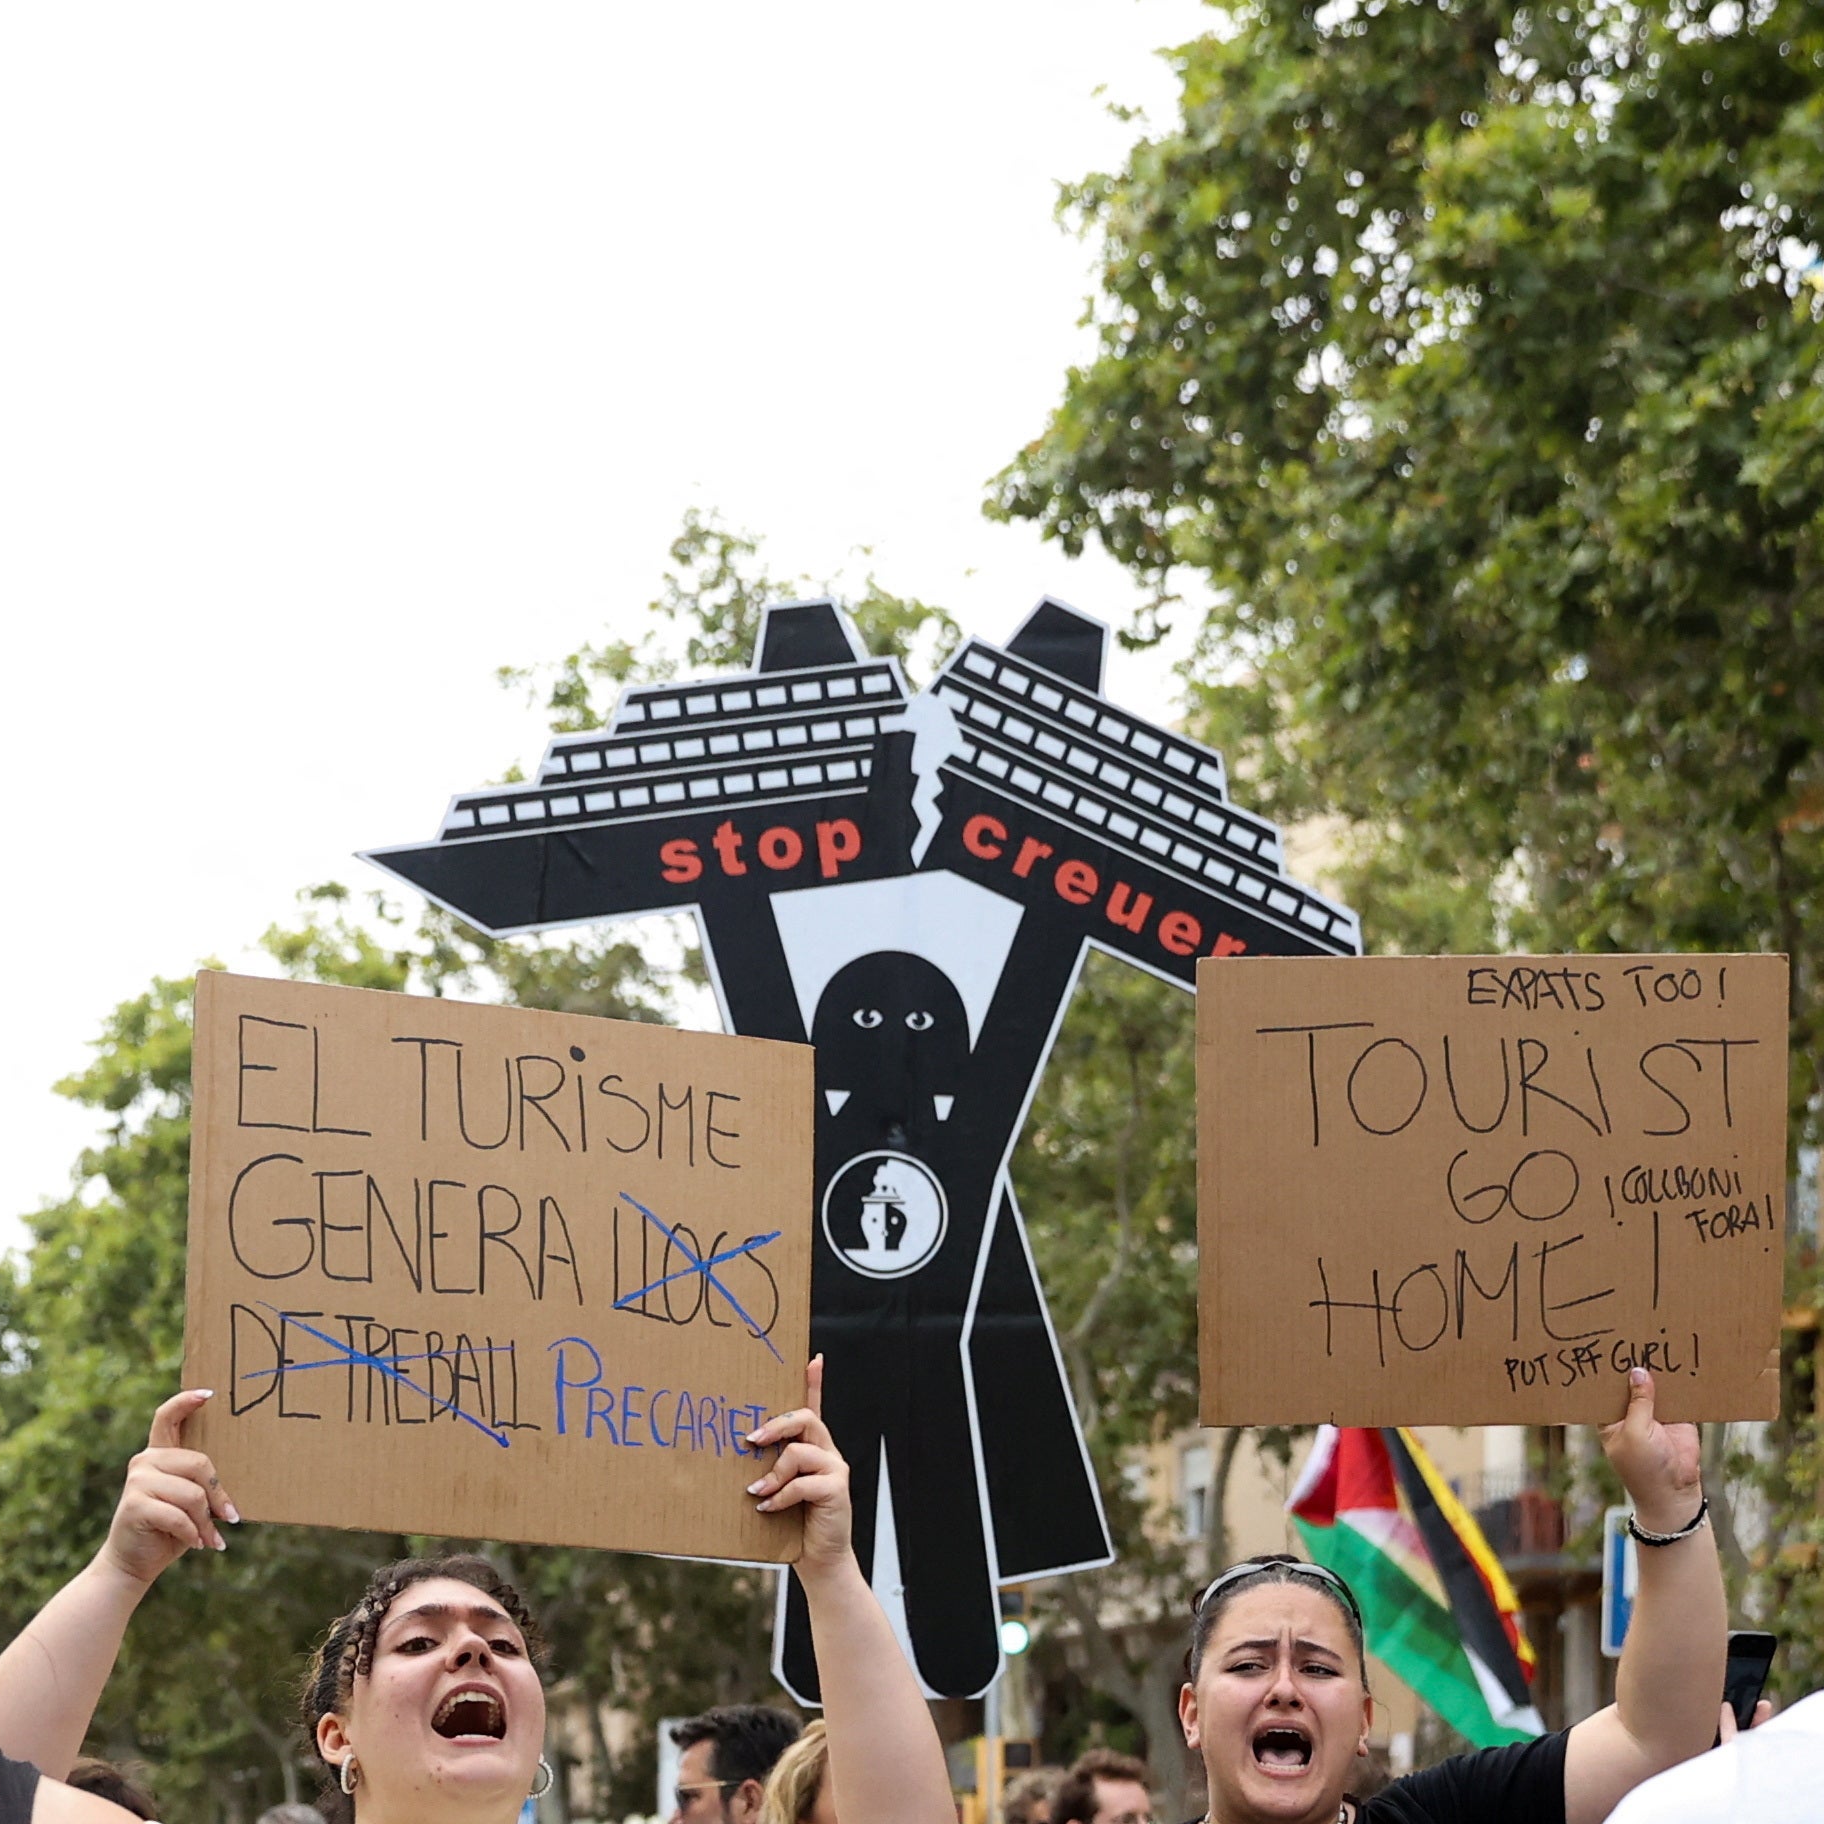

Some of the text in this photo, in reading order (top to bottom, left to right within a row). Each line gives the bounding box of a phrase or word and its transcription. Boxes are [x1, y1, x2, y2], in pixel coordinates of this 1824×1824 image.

[658, 812, 1269, 957] stop creuer
[1467, 967, 1605, 1011] EXPATS
[237, 1015, 740, 1169] EL TURISME
[1256, 1020, 1760, 1146] TOURIST
[229, 1153, 780, 1339] GENERA LLOCS
[1448, 1150, 1579, 1224] GO
[1684, 1193, 1774, 1253] FORA!
[230, 1303, 783, 1460] DE TREBALL PRECARIET
[1504, 1353, 1550, 1392] PUT
[1557, 1338, 1603, 1387] SPF
